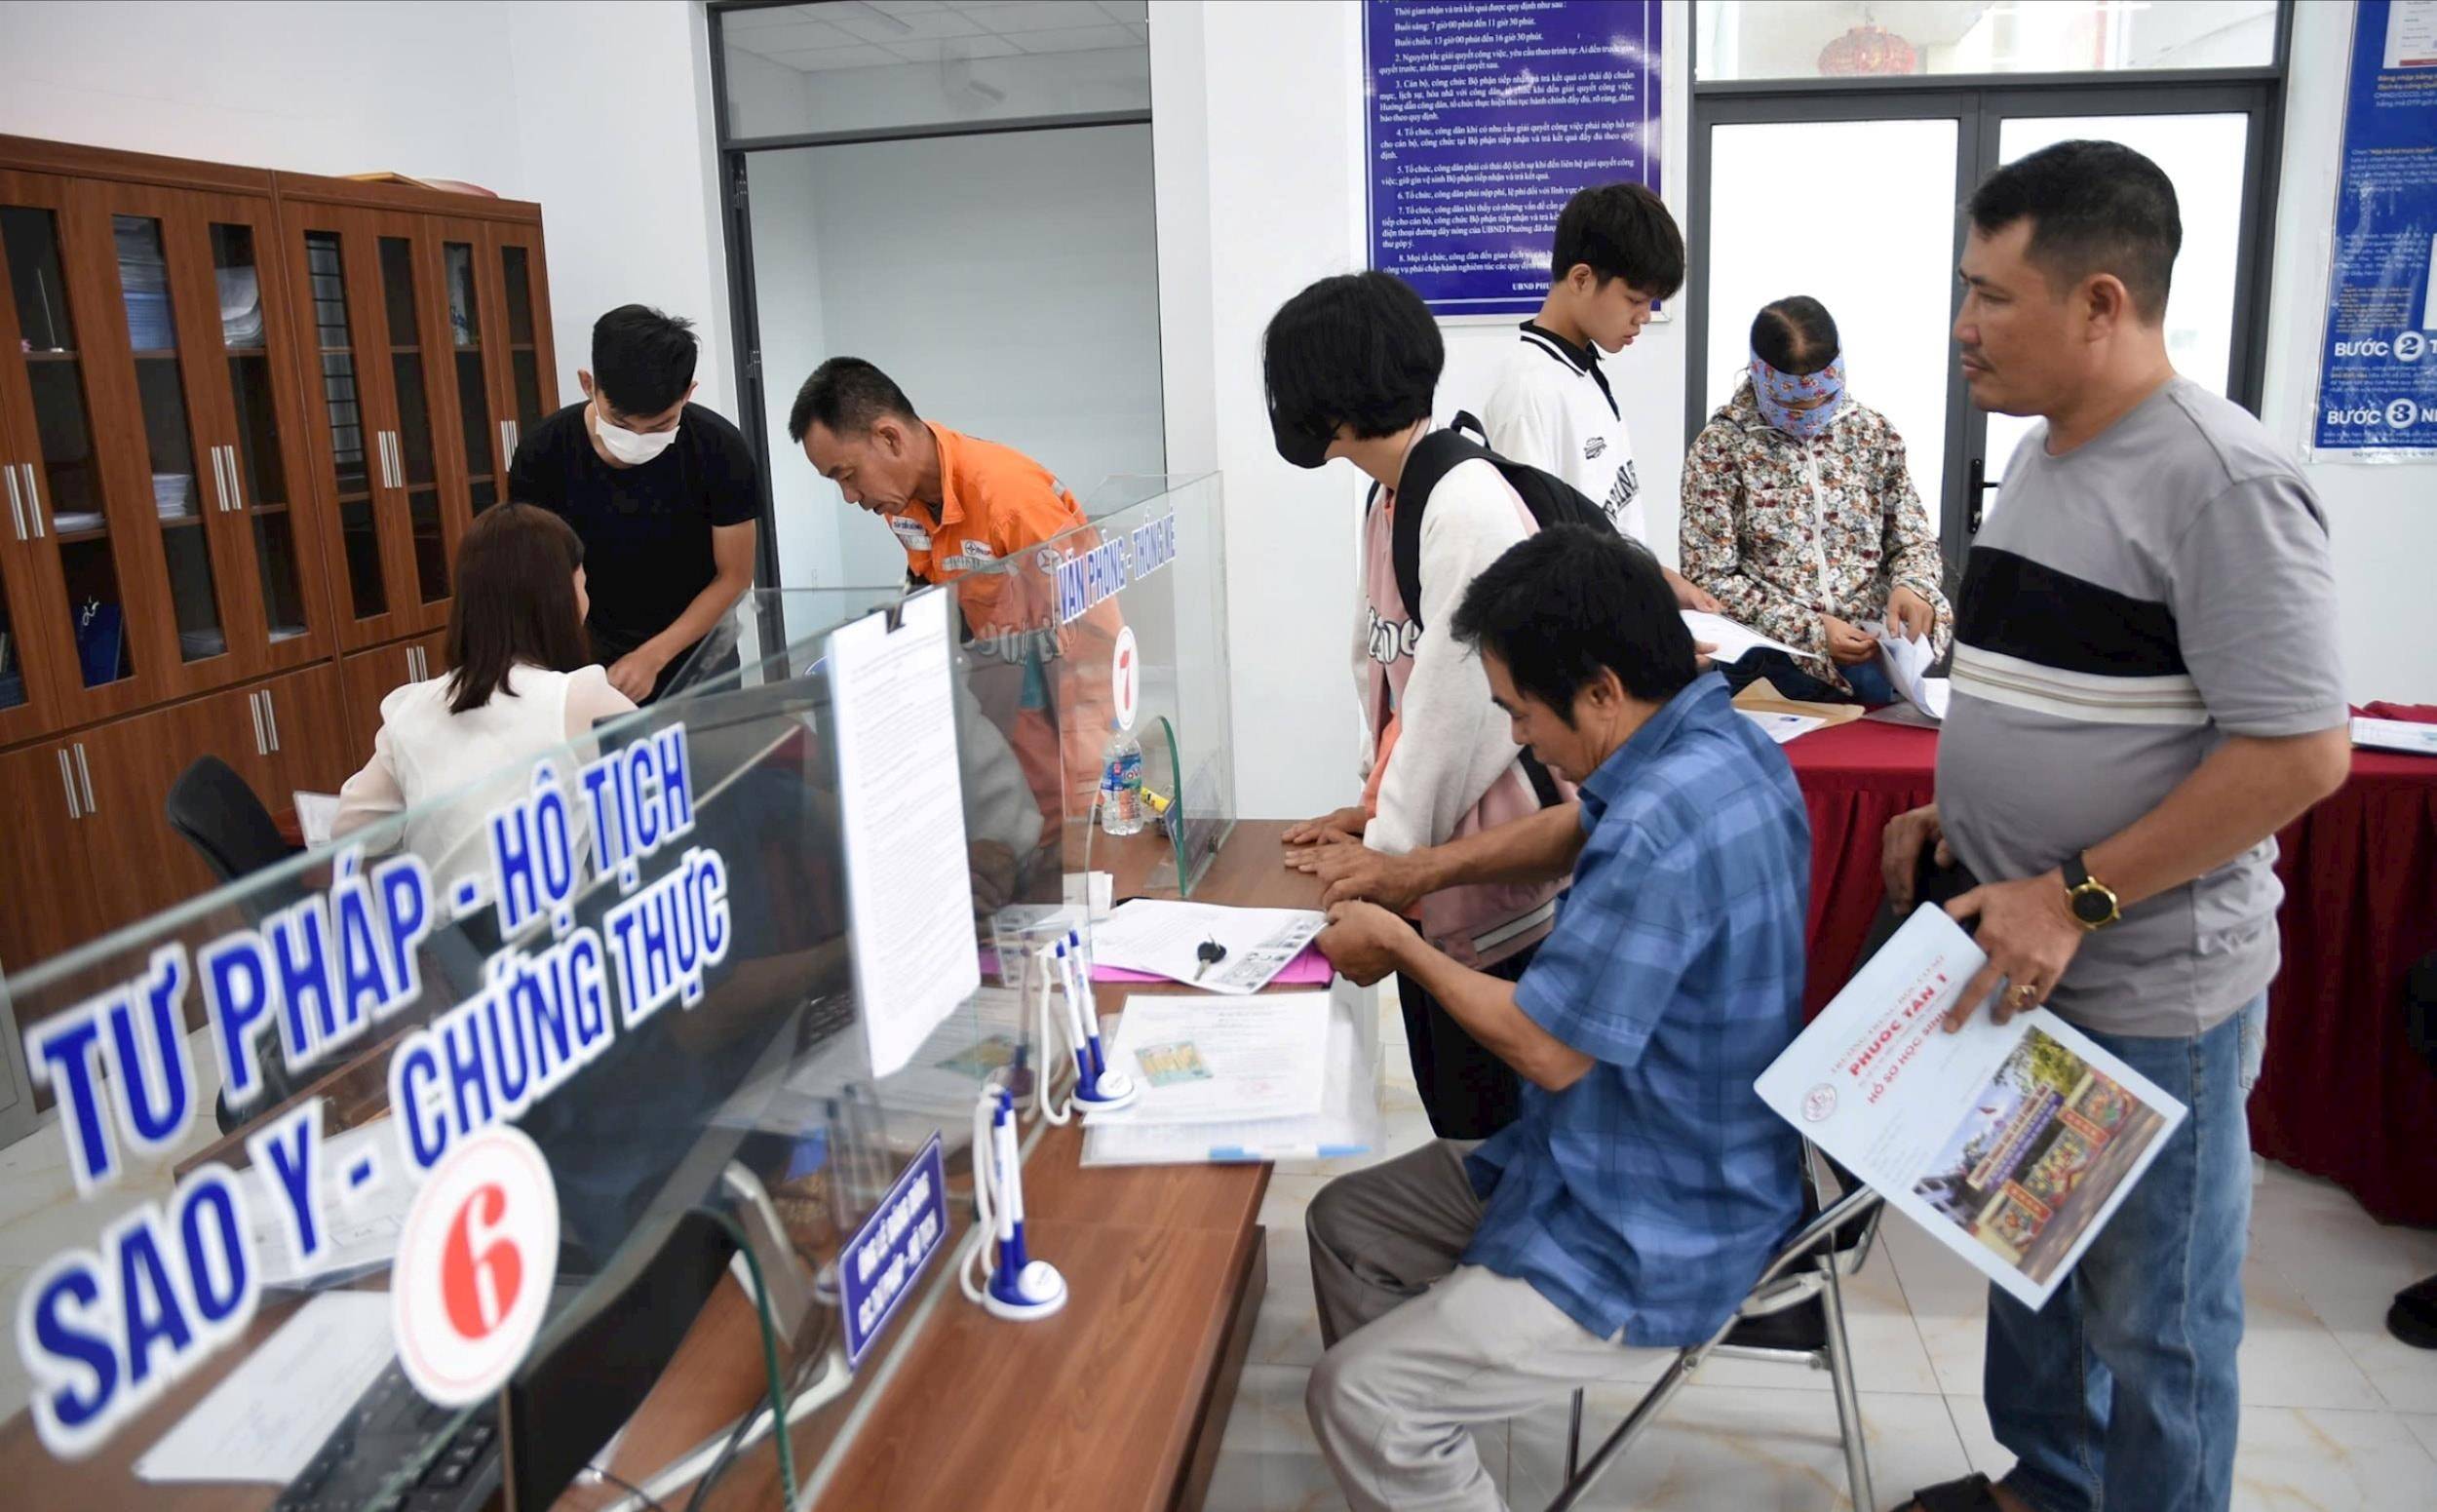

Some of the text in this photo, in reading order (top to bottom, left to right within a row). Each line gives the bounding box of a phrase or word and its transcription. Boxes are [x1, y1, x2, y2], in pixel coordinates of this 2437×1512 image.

[2334, 337, 2389, 357] BƯỚC
[2400, 336, 2418, 355] 2
[2327, 407, 2381, 424] BƯỚC
[2392, 404, 2410, 422] 3
[1057, 547, 1086, 624] VĂN
[1087, 529, 1127, 606] PHÒNG
[1133, 507, 1163, 581] THỐNG
[37, 953, 187, 1183] TƯ
[203, 848, 431, 1098] PHÁP
[455, 877, 479, 908] -
[491, 762, 574, 932] HỘ
[581, 727, 690, 885] TỊCH
[1897, 1036, 1922, 1065] HỌC
[31, 850, 728, 1433] SAO Y - CHỨNG THỰC
[440, 1181, 524, 1342] 6
